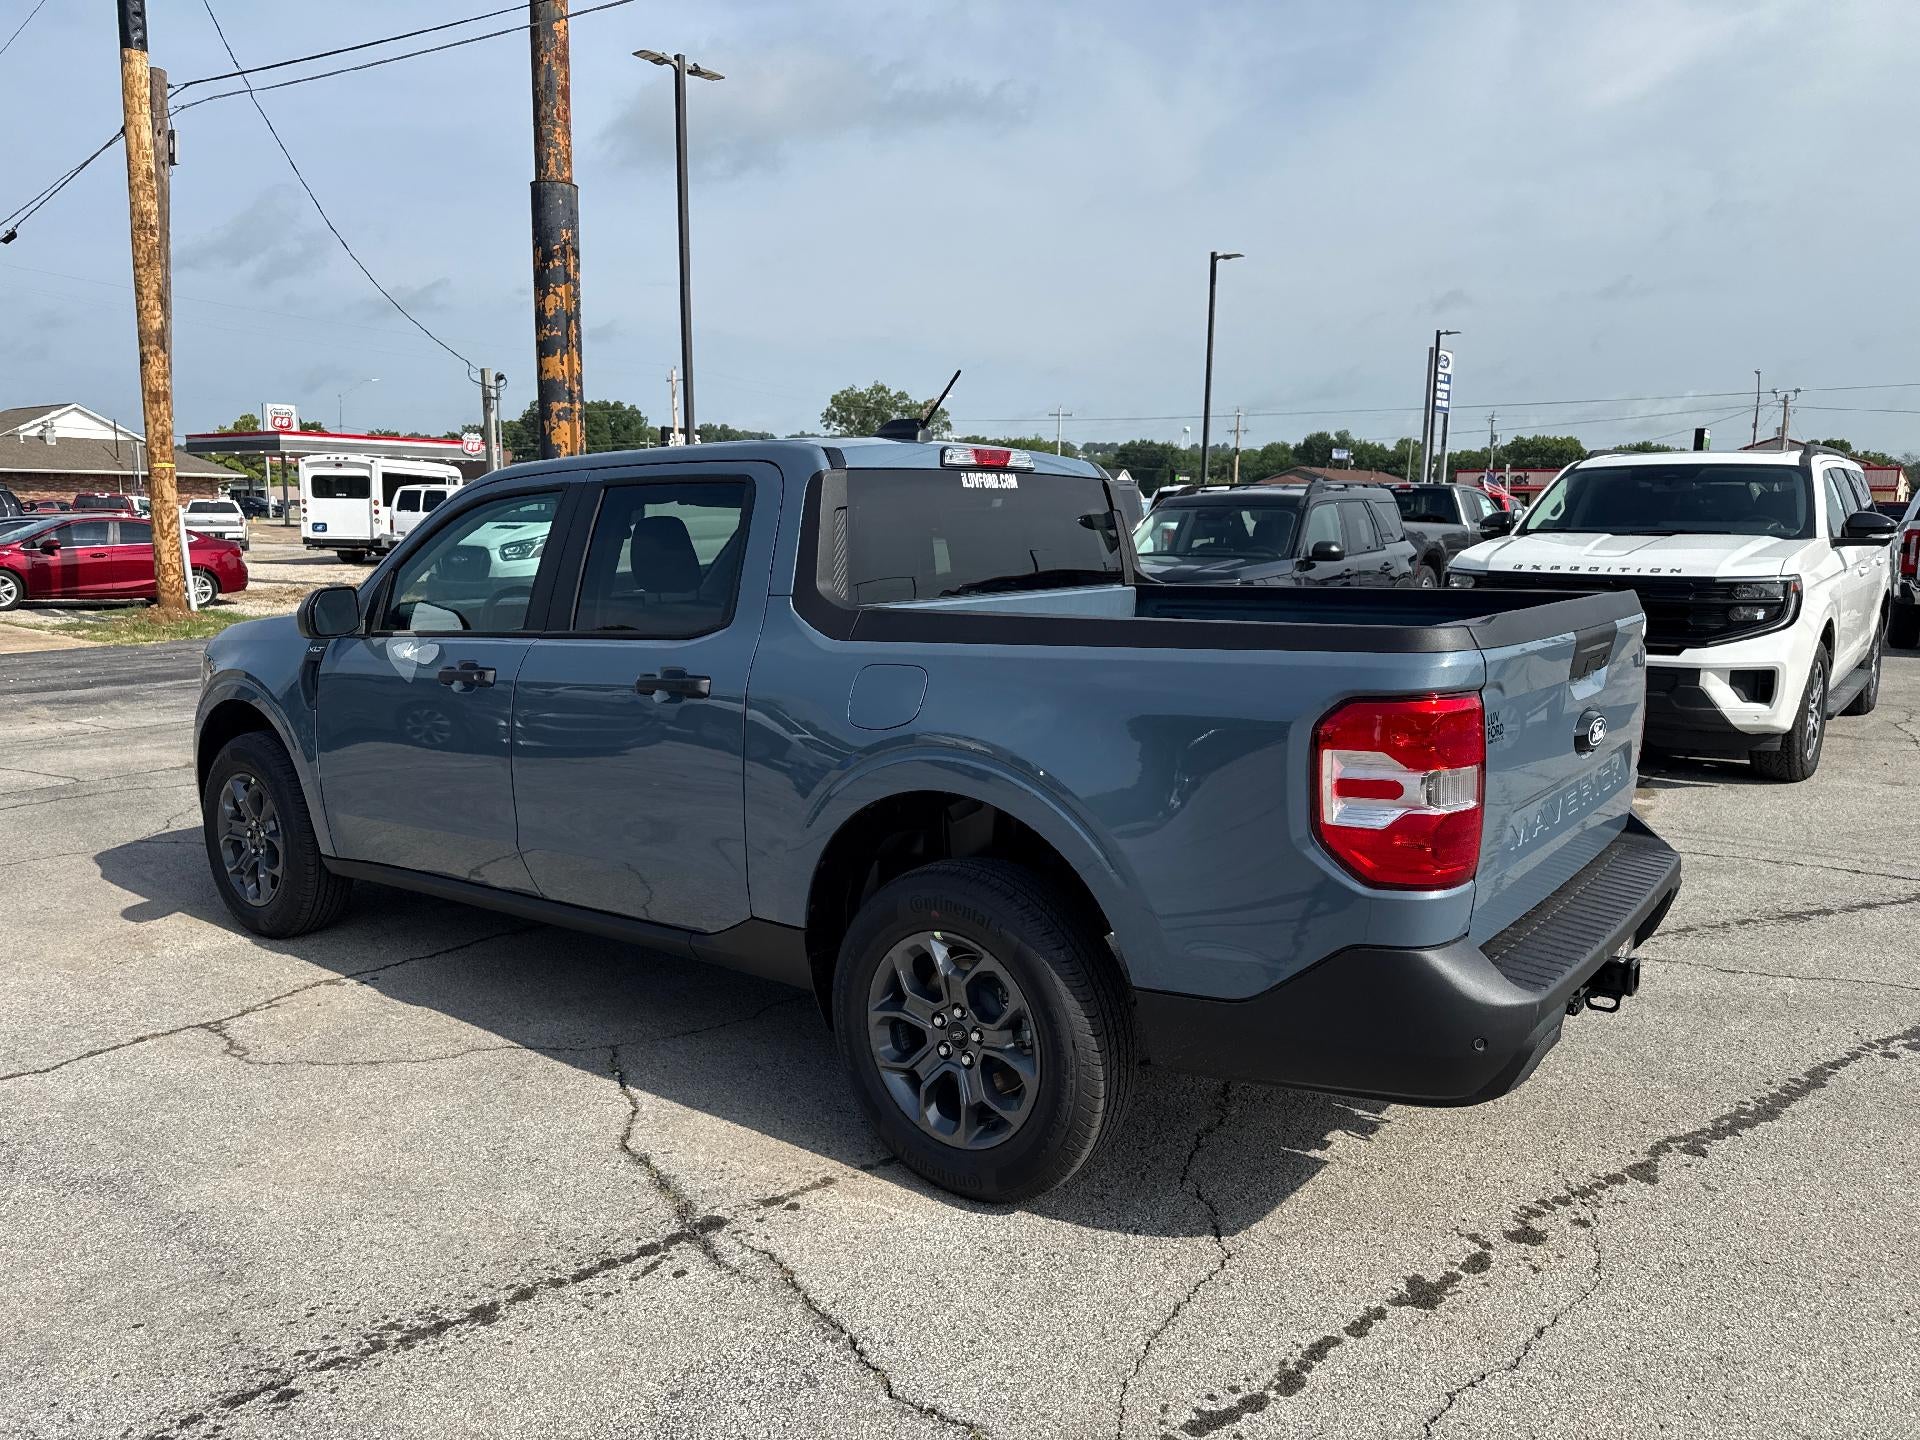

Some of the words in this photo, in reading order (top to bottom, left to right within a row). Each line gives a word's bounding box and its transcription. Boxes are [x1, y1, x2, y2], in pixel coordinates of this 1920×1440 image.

[274, 417, 289, 427] 66
[466, 442, 479, 451] 66
[1512, 563, 1683, 574] EXPEDITION
[1486, 711, 1500, 726] LUV
[1487, 722, 1505, 740] FORD
[910, 895, 993, 930] Continental
